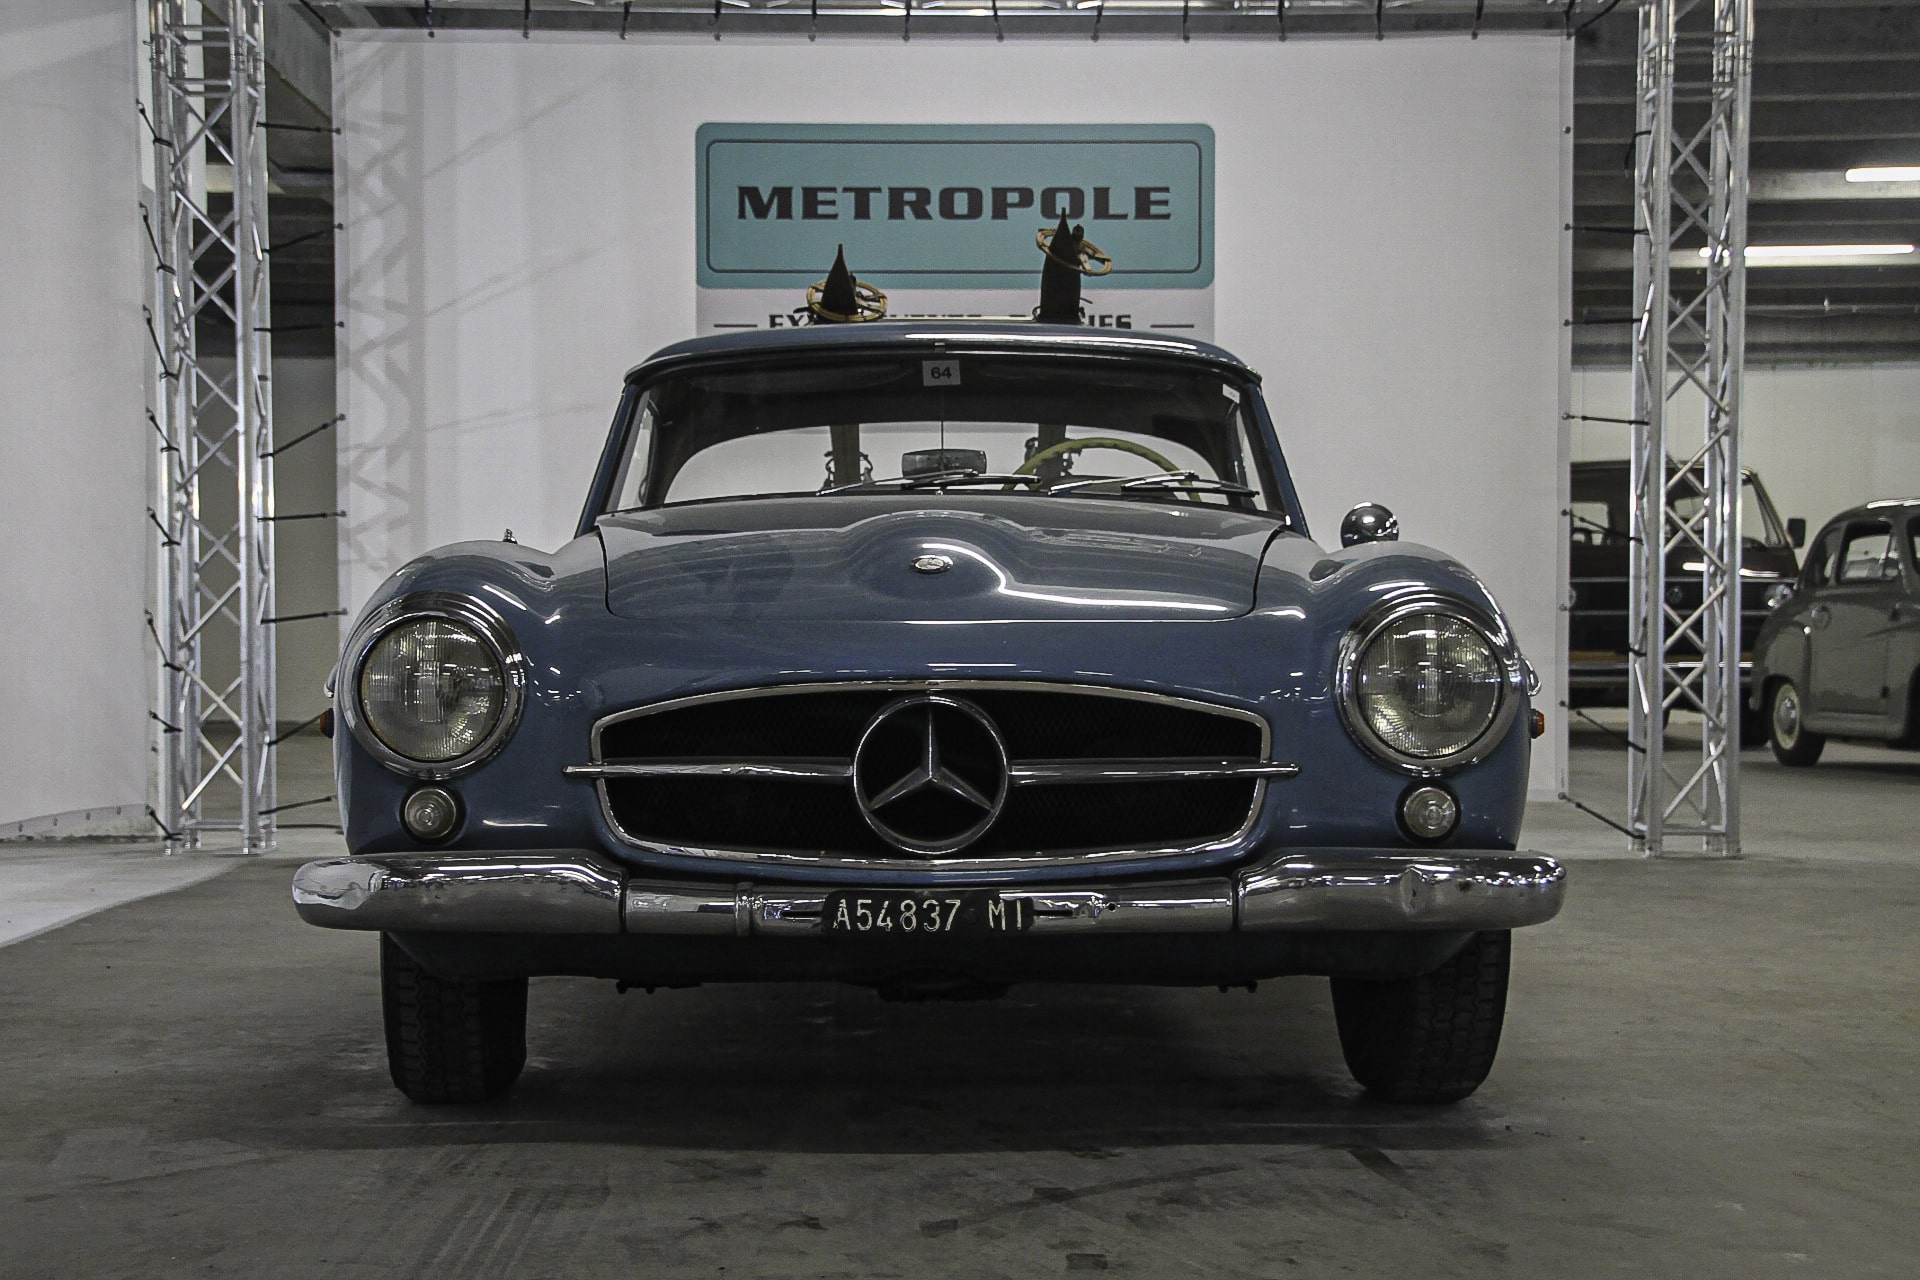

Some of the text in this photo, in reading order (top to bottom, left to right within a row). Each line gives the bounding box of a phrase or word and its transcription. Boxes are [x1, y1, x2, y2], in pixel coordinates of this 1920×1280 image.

[737, 185, 1171, 221] METROPOLE
[930, 366, 953, 380] 64
[832, 898, 1022, 932] A54837 MI
